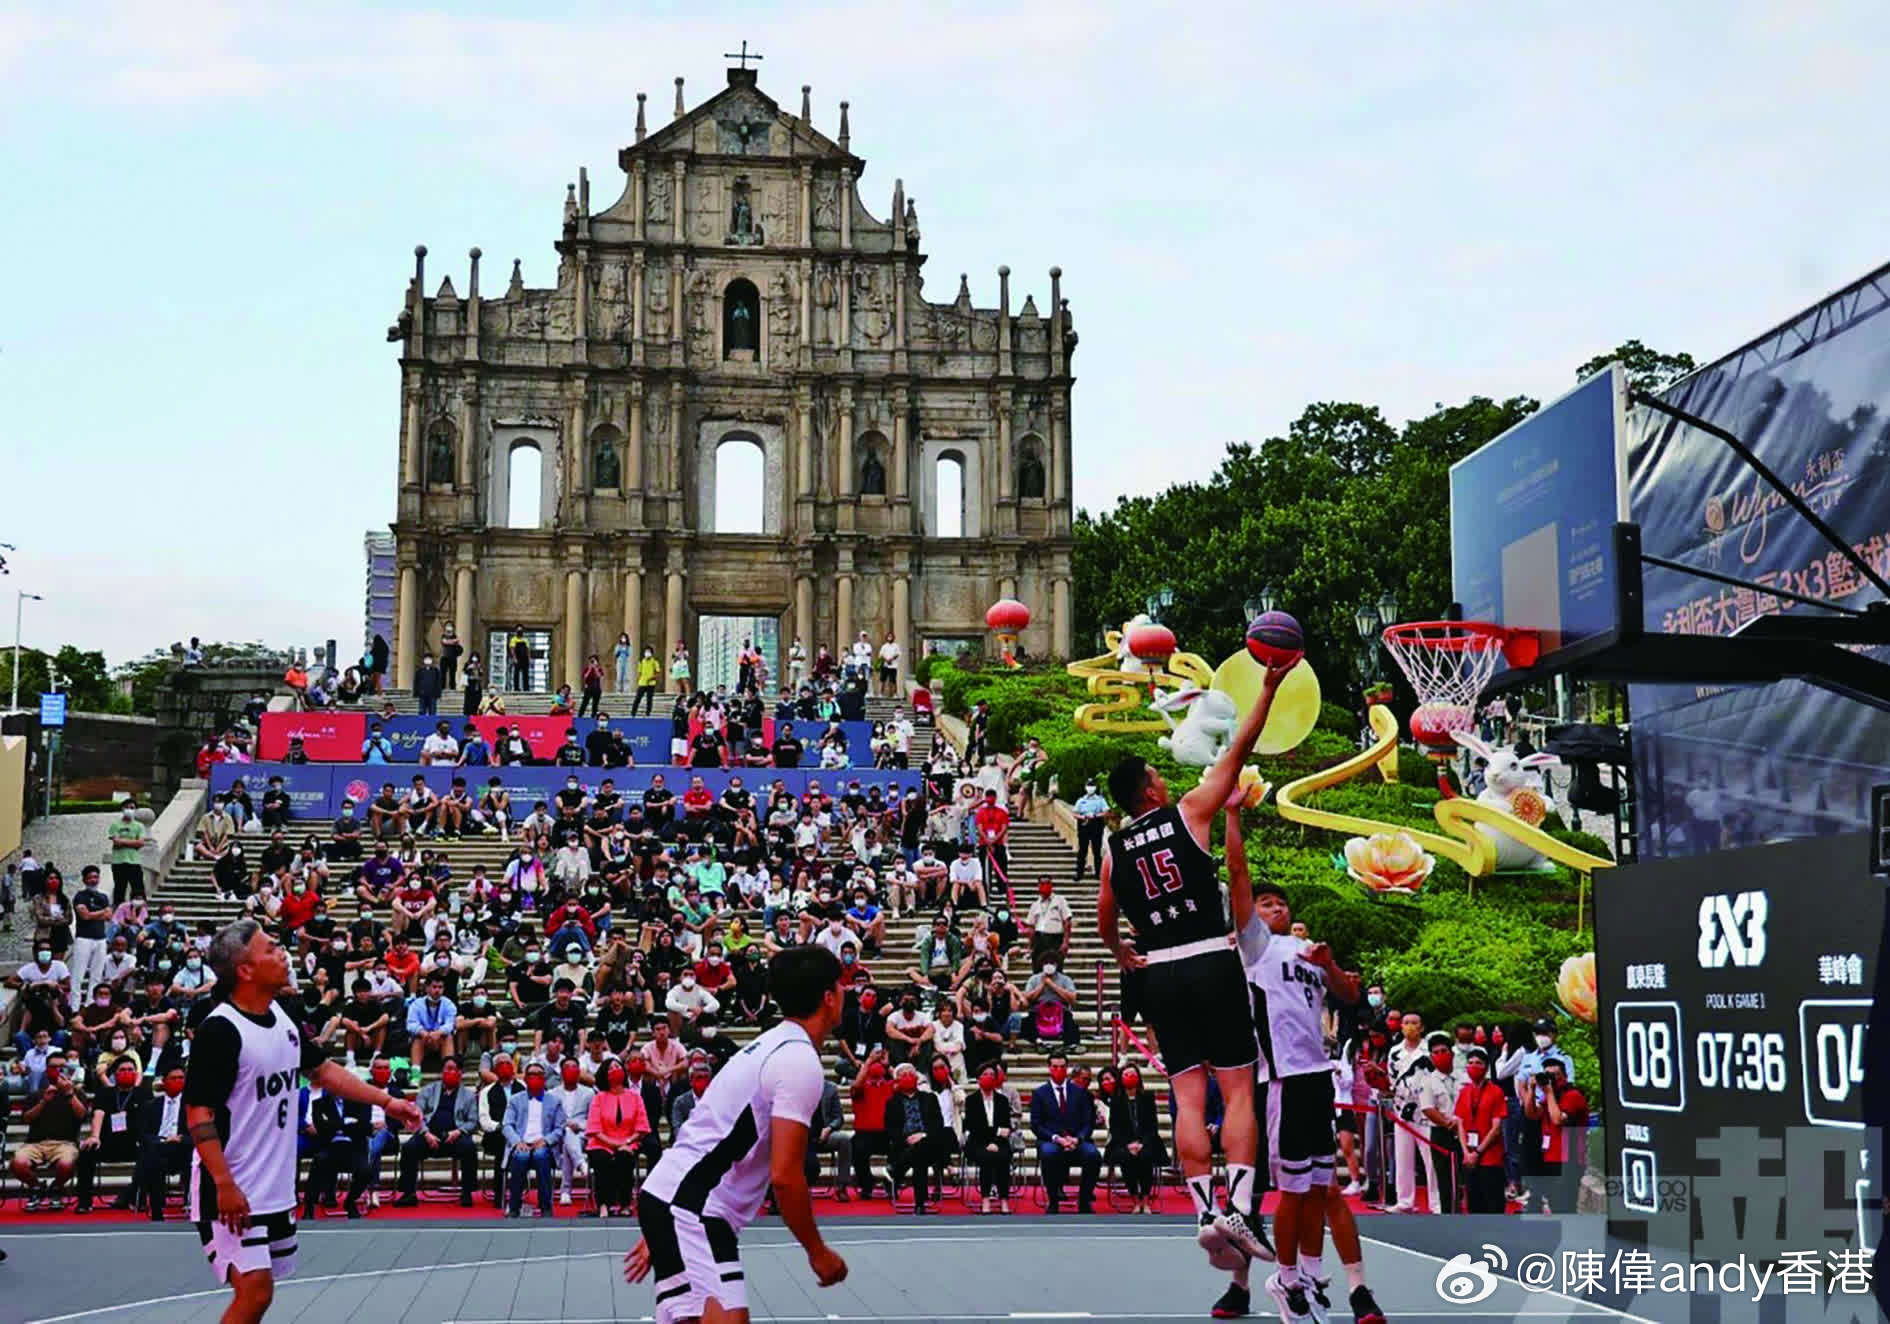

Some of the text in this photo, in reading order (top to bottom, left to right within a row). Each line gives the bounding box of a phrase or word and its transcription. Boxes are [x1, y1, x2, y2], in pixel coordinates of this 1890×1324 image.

[1135, 847, 1185, 901] 15
[1625, 1021, 1673, 1089] 08
[1696, 1031, 1787, 1093] 07:36
[277, 1098, 289, 1130] 6
[1631, 1159, 1648, 1200] 0
